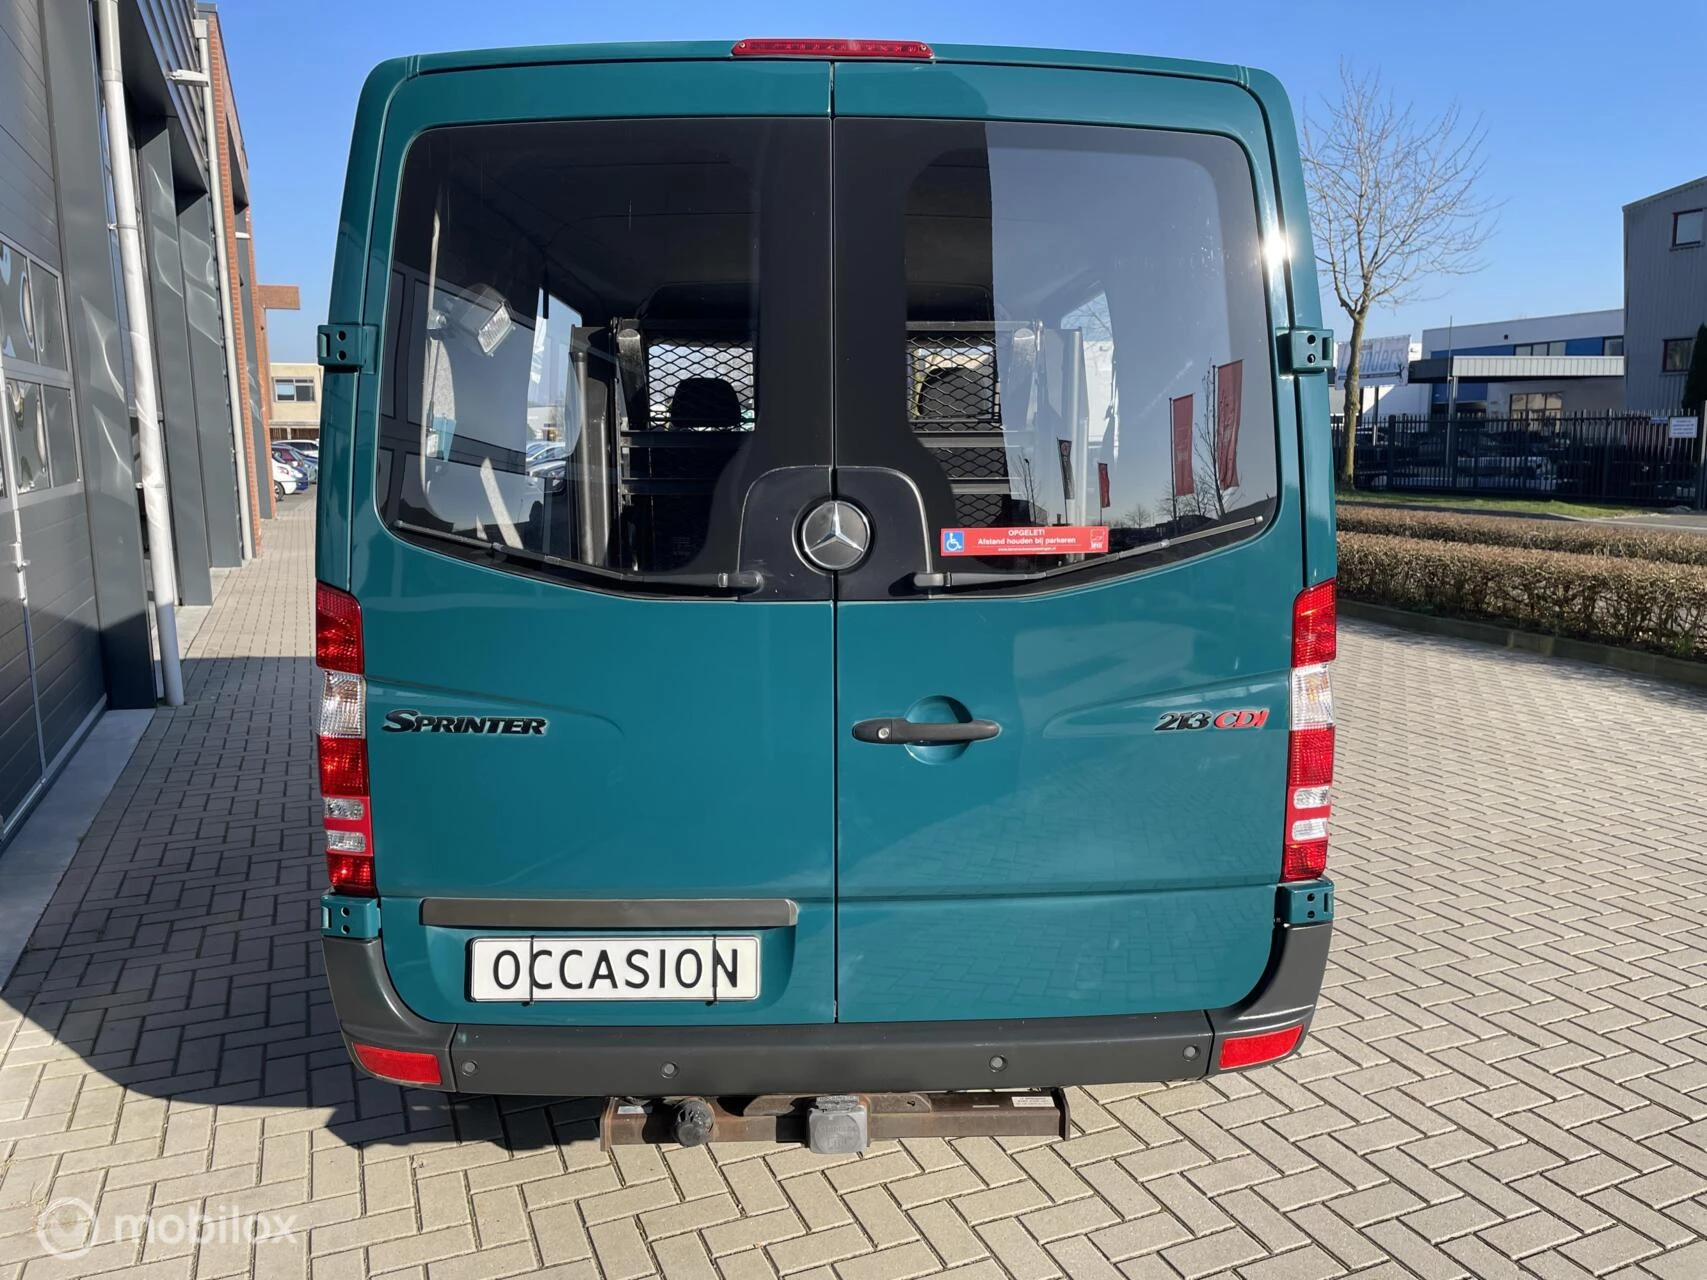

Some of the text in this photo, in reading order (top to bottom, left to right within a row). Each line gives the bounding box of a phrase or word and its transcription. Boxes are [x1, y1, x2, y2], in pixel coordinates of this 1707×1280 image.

[1035, 538, 1044, 546] bij
[1045, 537, 1076, 546] parkeren
[381, 709, 547, 735] SPRINTER
[1154, 708, 1269, 731] 213 CDI
[493, 949, 738, 990] OCCASION
